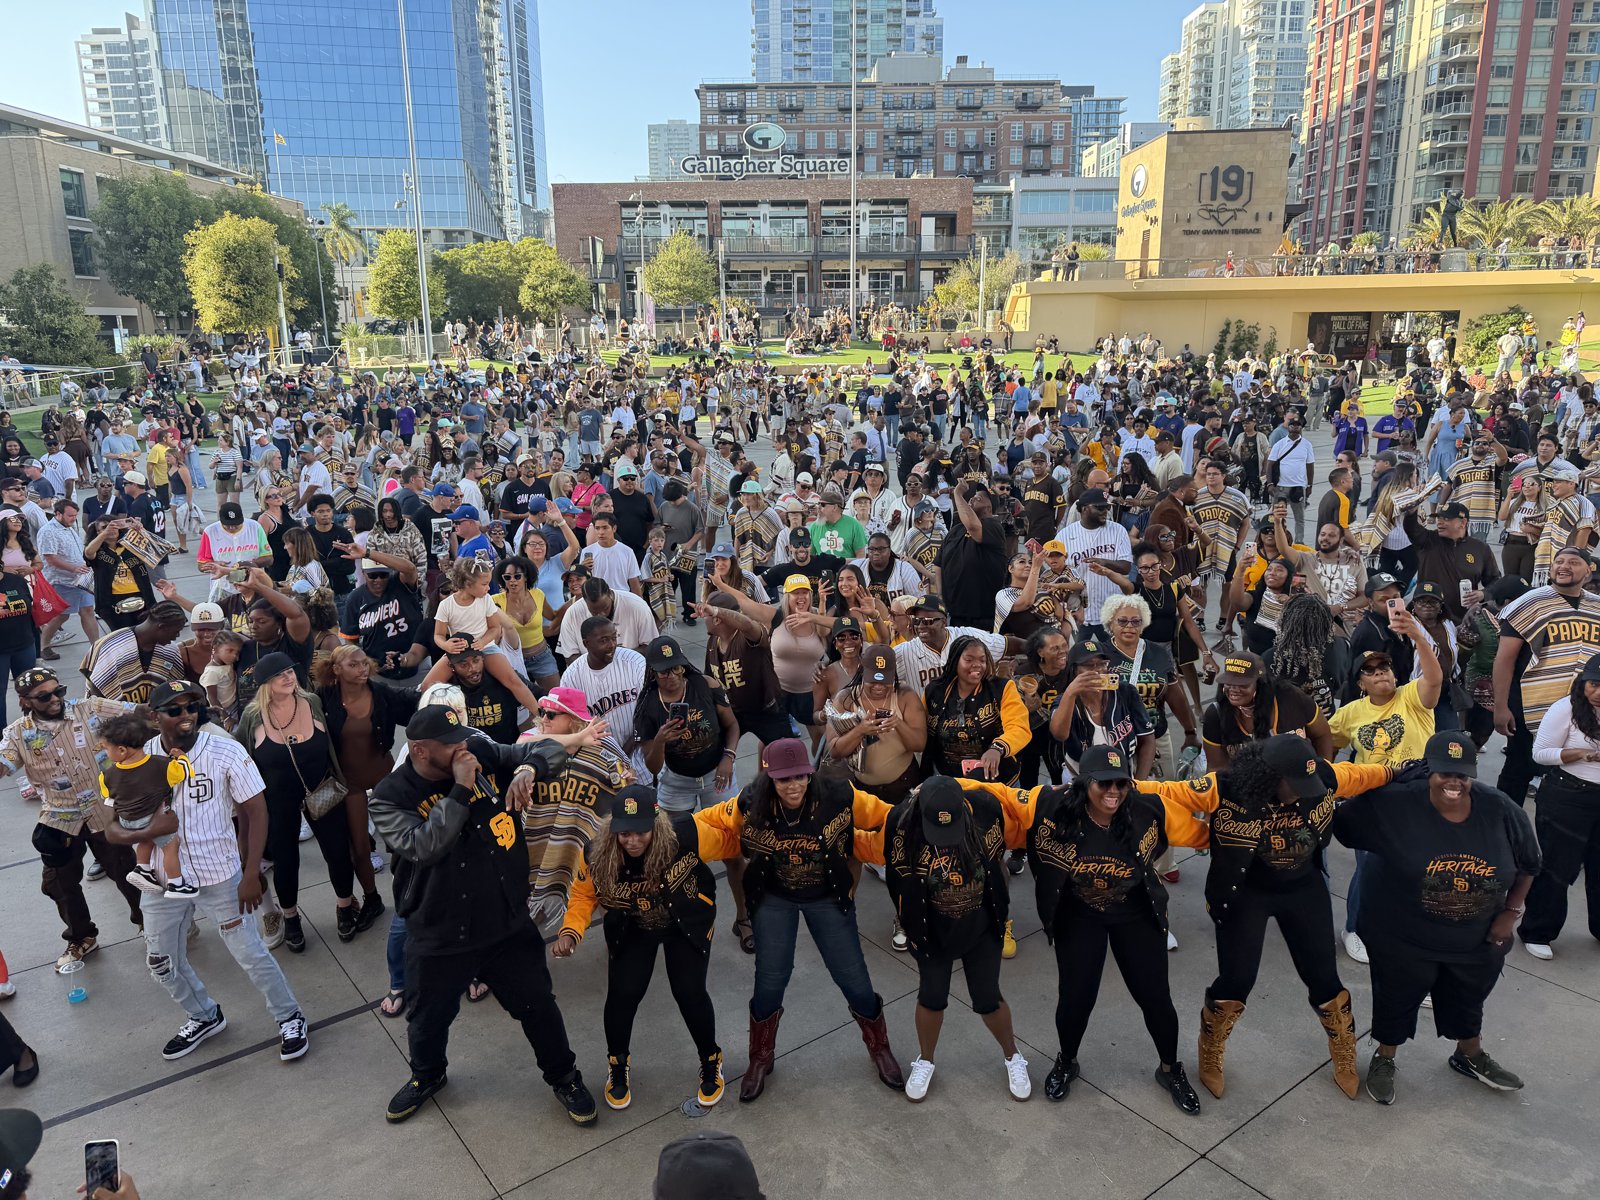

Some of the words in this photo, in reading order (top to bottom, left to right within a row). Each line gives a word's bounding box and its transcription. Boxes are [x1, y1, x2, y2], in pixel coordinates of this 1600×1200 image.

[681, 157, 776, 177] Gallagher
[781, 157, 849, 177] Square
[1209, 164, 1245, 202] 19
[1121, 202, 1141, 217] Gallagher
[1141, 199, 1158, 212] Square
[1231, 228, 1262, 236] TERRACE
[1332, 321, 1346, 330] HALL
[1346, 321, 1354, 330] OF
[1354, 320, 1369, 330] FAME
[516, 494, 528, 505] SAN
[827, 534, 838, 549] SD
[1070, 543, 1116, 567] PADRES
[788, 576, 808, 587] PADRES
[384, 619, 409, 638] 23
[1547, 621, 1600, 643] PADRE
[875, 655, 886, 669] SD
[1225, 658, 1234, 666] SAN
[1234, 659, 1252, 668] DIEGO
[1226, 665, 1246, 674] PADRES
[1119, 672, 1157, 683] TEY
[1139, 683, 1160, 697] OT
[444, 710, 459, 727] SD
[1448, 741, 1463, 759] SD
[1108, 751, 1121, 768] SD
[188, 773, 213, 804] SD
[625, 797, 638, 814] SD
[938, 811, 952, 825] SD
[1214, 808, 1262, 839] South
[1263, 815, 1304, 832] RITAGE
[489, 811, 516, 851] SD
[744, 825, 777, 848] outh
[1035, 824, 1078, 863] South
[789, 853, 802, 865] SD
[1071, 861, 1136, 879] HERITAGE
[1426, 860, 1497, 877] HERITAGE
[949, 871, 964, 887] SD
[1453, 877, 1469, 892] SD
[637, 897, 652, 912] SD
